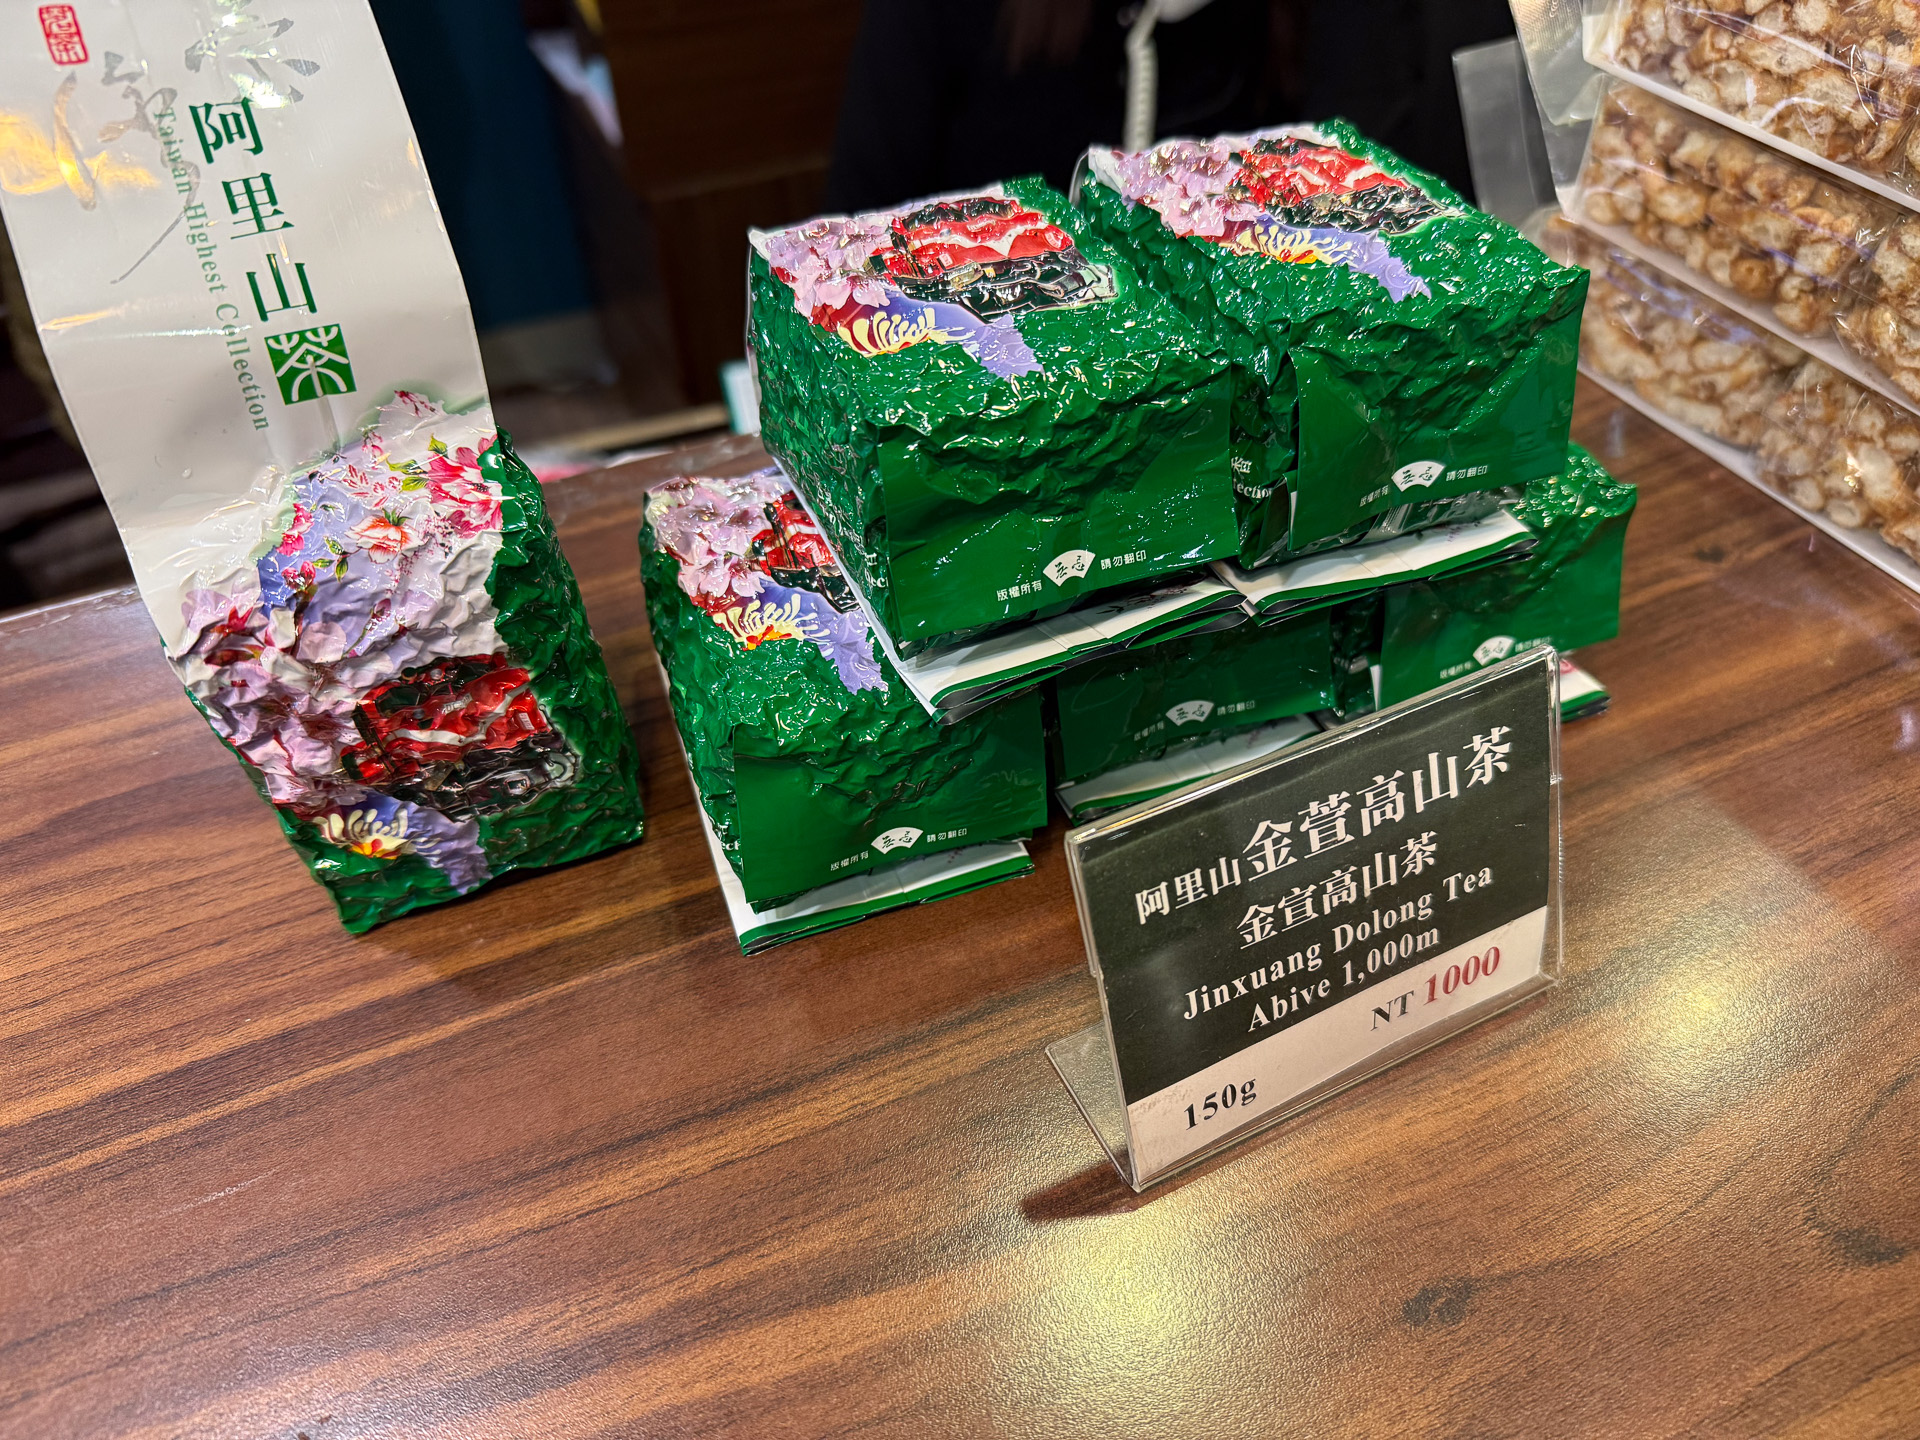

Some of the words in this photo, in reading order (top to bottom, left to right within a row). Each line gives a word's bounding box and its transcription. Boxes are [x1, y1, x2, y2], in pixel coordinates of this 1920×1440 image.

[154, 107, 193, 195] Taiwan
[184, 202, 228, 293] Highest
[216, 303, 269, 431] Collection
[996, 579, 1043, 602] 版權所有
[1100, 550, 1147, 571] 請勿翻印
[830, 850, 869, 871] 版權所有
[926, 828, 968, 843] 請勿翻印
[1135, 726, 1512, 925] 阿里山金萱高山茶
[1183, 943, 1323, 1020] Jinxuang
[1331, 892, 1434, 953] Dolong
[1442, 866, 1493, 903] Tea
[1237, 830, 1438, 950] 金宣高山茶
[1247, 978, 1332, 1033] Abive
[1341, 926, 1440, 986] 1,000m
[1371, 990, 1415, 1031] NT
[1423, 945, 1501, 1006] 1000
[1183, 1079, 1258, 1131] 150g
